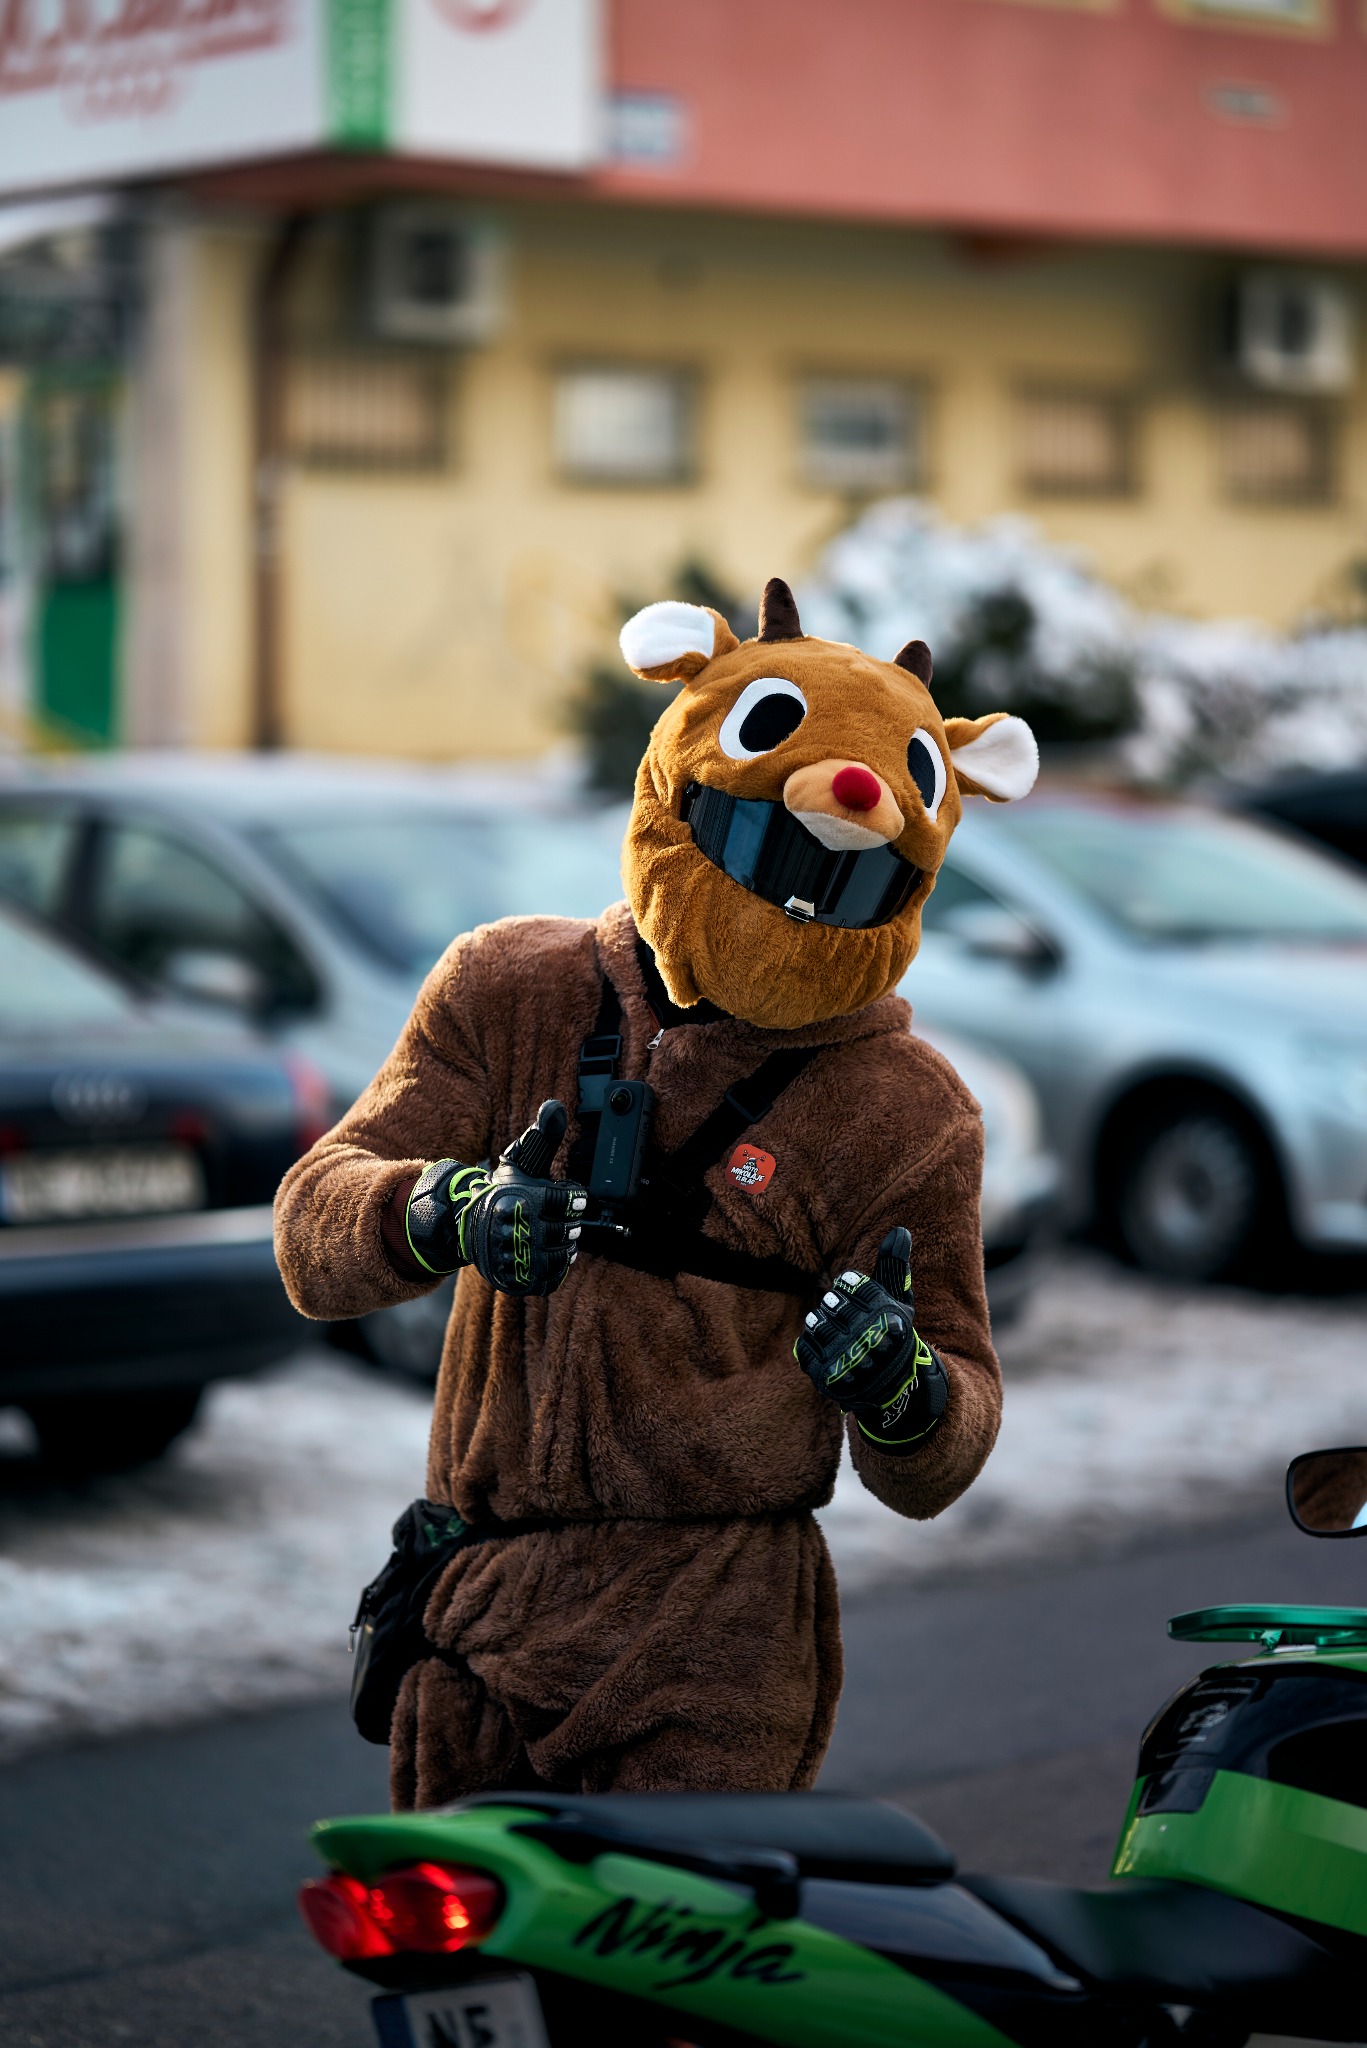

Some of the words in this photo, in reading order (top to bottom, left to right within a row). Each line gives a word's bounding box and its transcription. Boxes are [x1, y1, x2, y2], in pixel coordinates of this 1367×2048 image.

[742, 1164, 759, 1174] MOTO
[513, 1200, 531, 1287] RST
[826, 1312, 889, 1386] RST
[571, 1895, 809, 1991] Ninja
